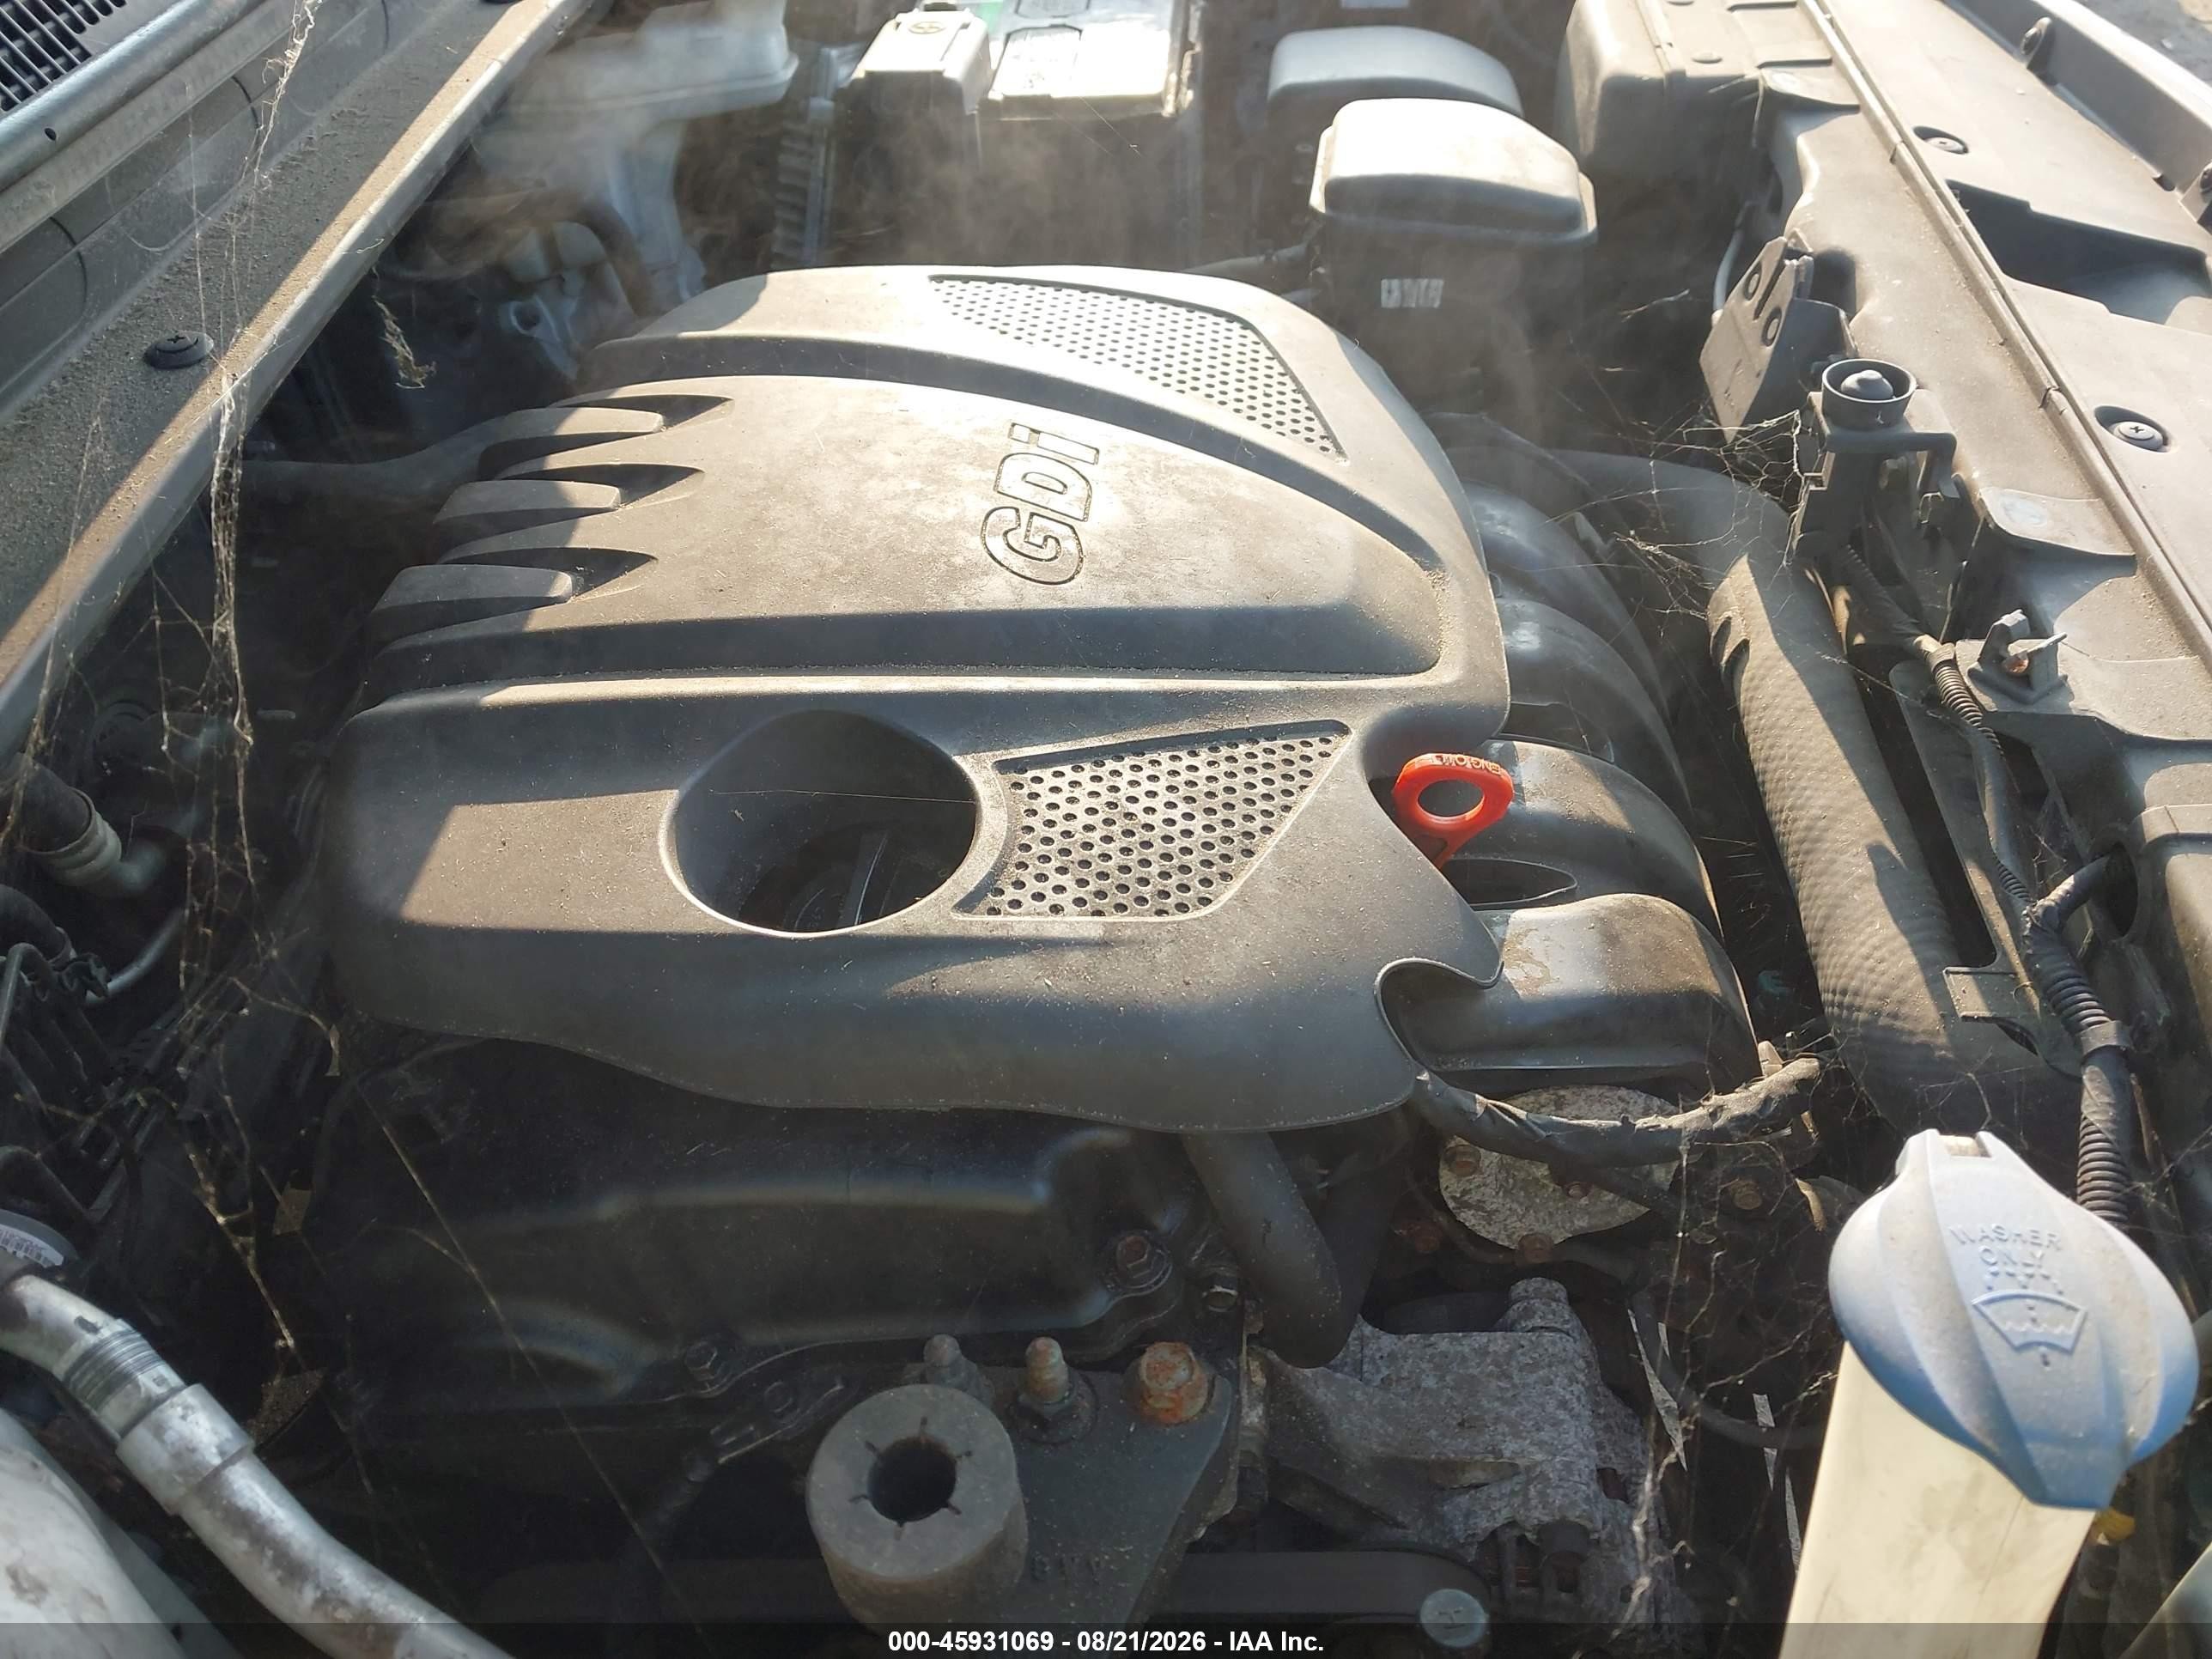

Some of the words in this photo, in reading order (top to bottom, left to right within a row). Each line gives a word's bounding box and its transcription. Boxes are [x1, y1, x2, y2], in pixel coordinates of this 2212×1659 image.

[981, 422, 1099, 586] GDi
[1948, 1222, 2063, 1251] WASHER
[1978, 1244, 2045, 1269] ONLY
